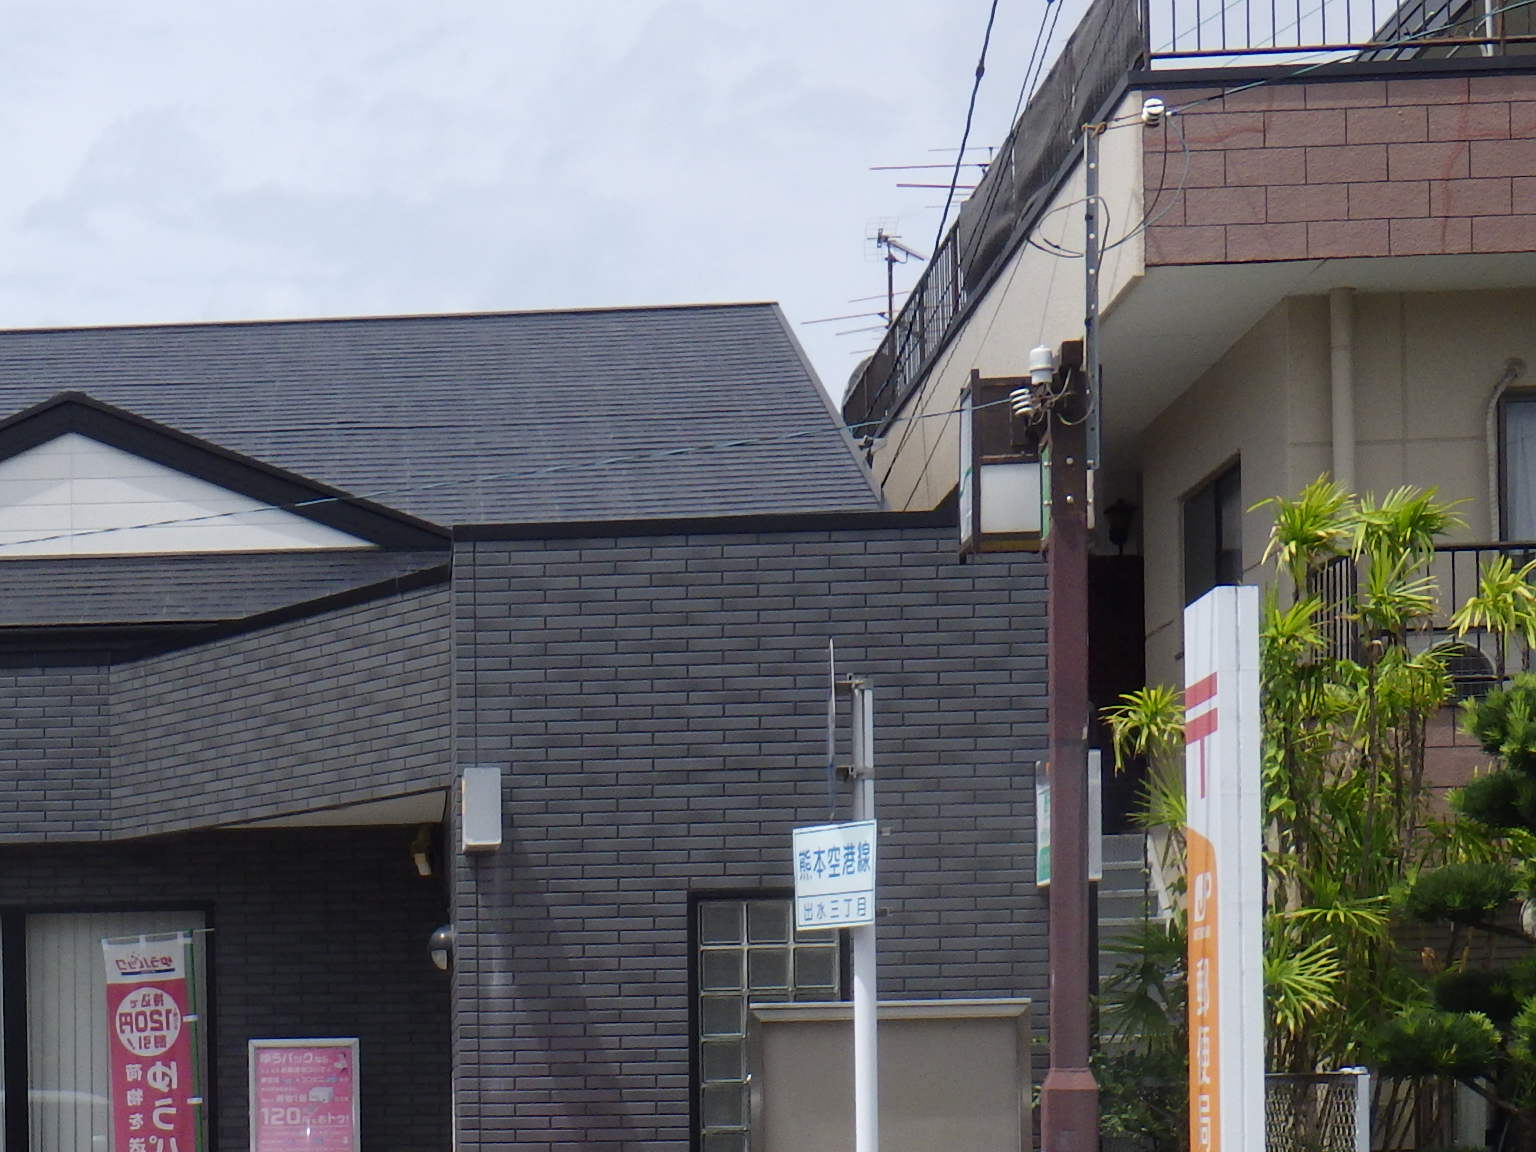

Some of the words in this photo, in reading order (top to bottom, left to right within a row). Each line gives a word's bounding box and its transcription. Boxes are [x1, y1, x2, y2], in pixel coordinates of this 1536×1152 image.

[798, 840, 871, 880] 熊本空港線
[804, 896, 866, 921] 出水三丁目
